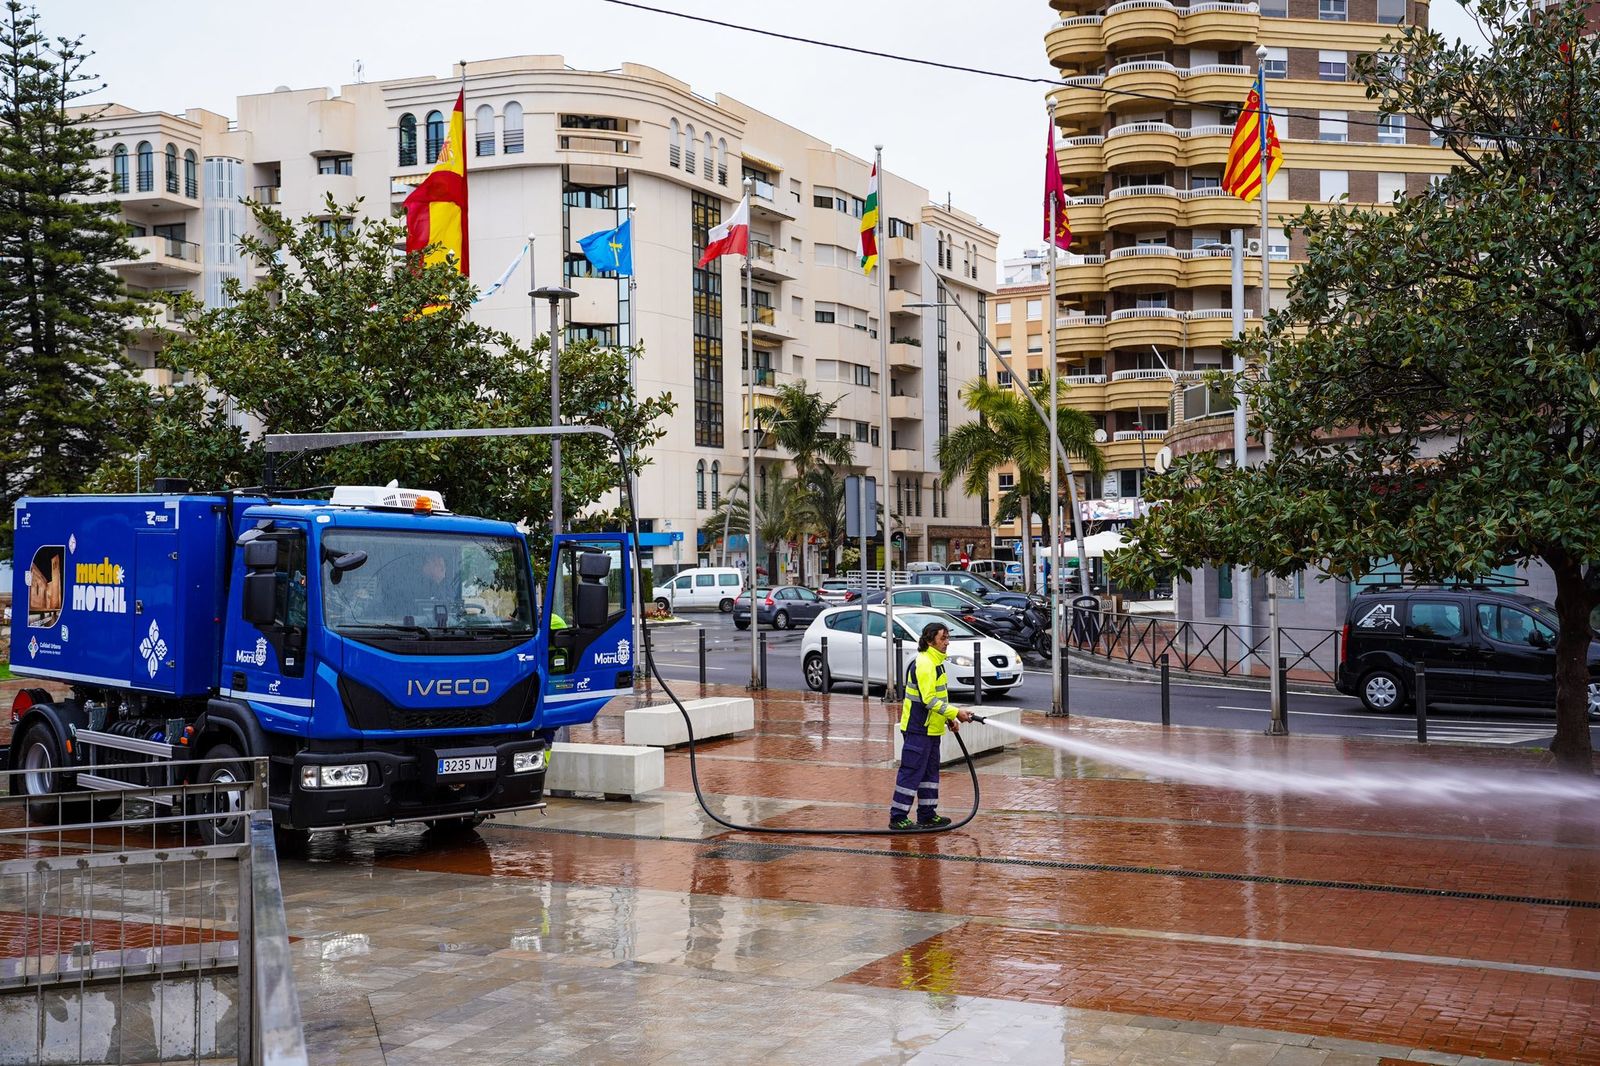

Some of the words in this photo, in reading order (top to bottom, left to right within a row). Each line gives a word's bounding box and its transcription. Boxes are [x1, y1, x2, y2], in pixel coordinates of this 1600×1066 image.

[73, 585, 126, 613] MOTRIL
[236, 650, 256, 663] Motril
[594, 652, 619, 665] Motril
[407, 678, 489, 696] IVECO
[444, 759, 471, 772] 3235
[474, 757, 494, 770] NJY
